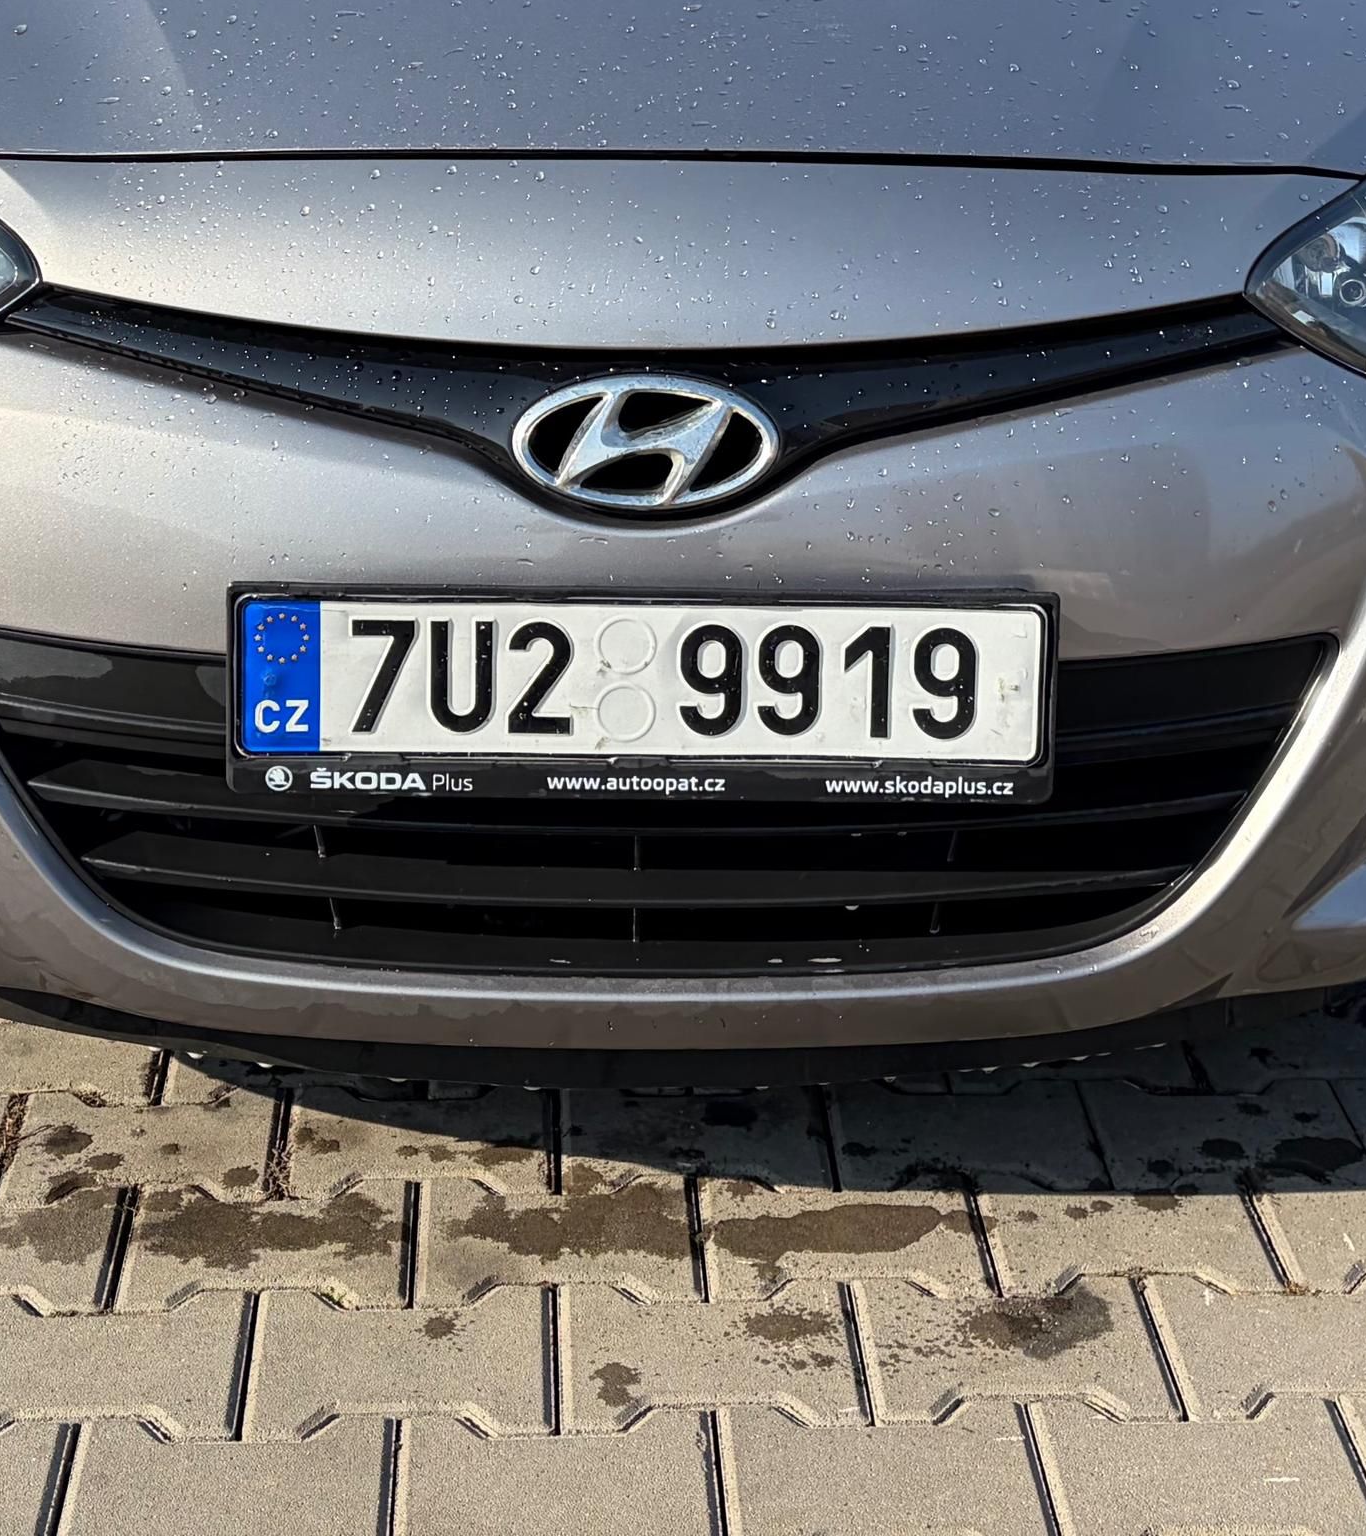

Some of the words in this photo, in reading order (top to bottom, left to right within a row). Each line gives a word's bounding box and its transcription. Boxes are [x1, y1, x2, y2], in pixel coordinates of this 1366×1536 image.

[351, 619, 572, 735] 7U2
[679, 624, 977, 740] 9919
[254, 699, 309, 733] CZ
[310, 768, 426, 790] ŠKODA
[432, 773, 473, 792] Plus
[547, 775, 725, 795] www.autoopat.cz
[825, 777, 1014, 797] www.skodaplus.cz
